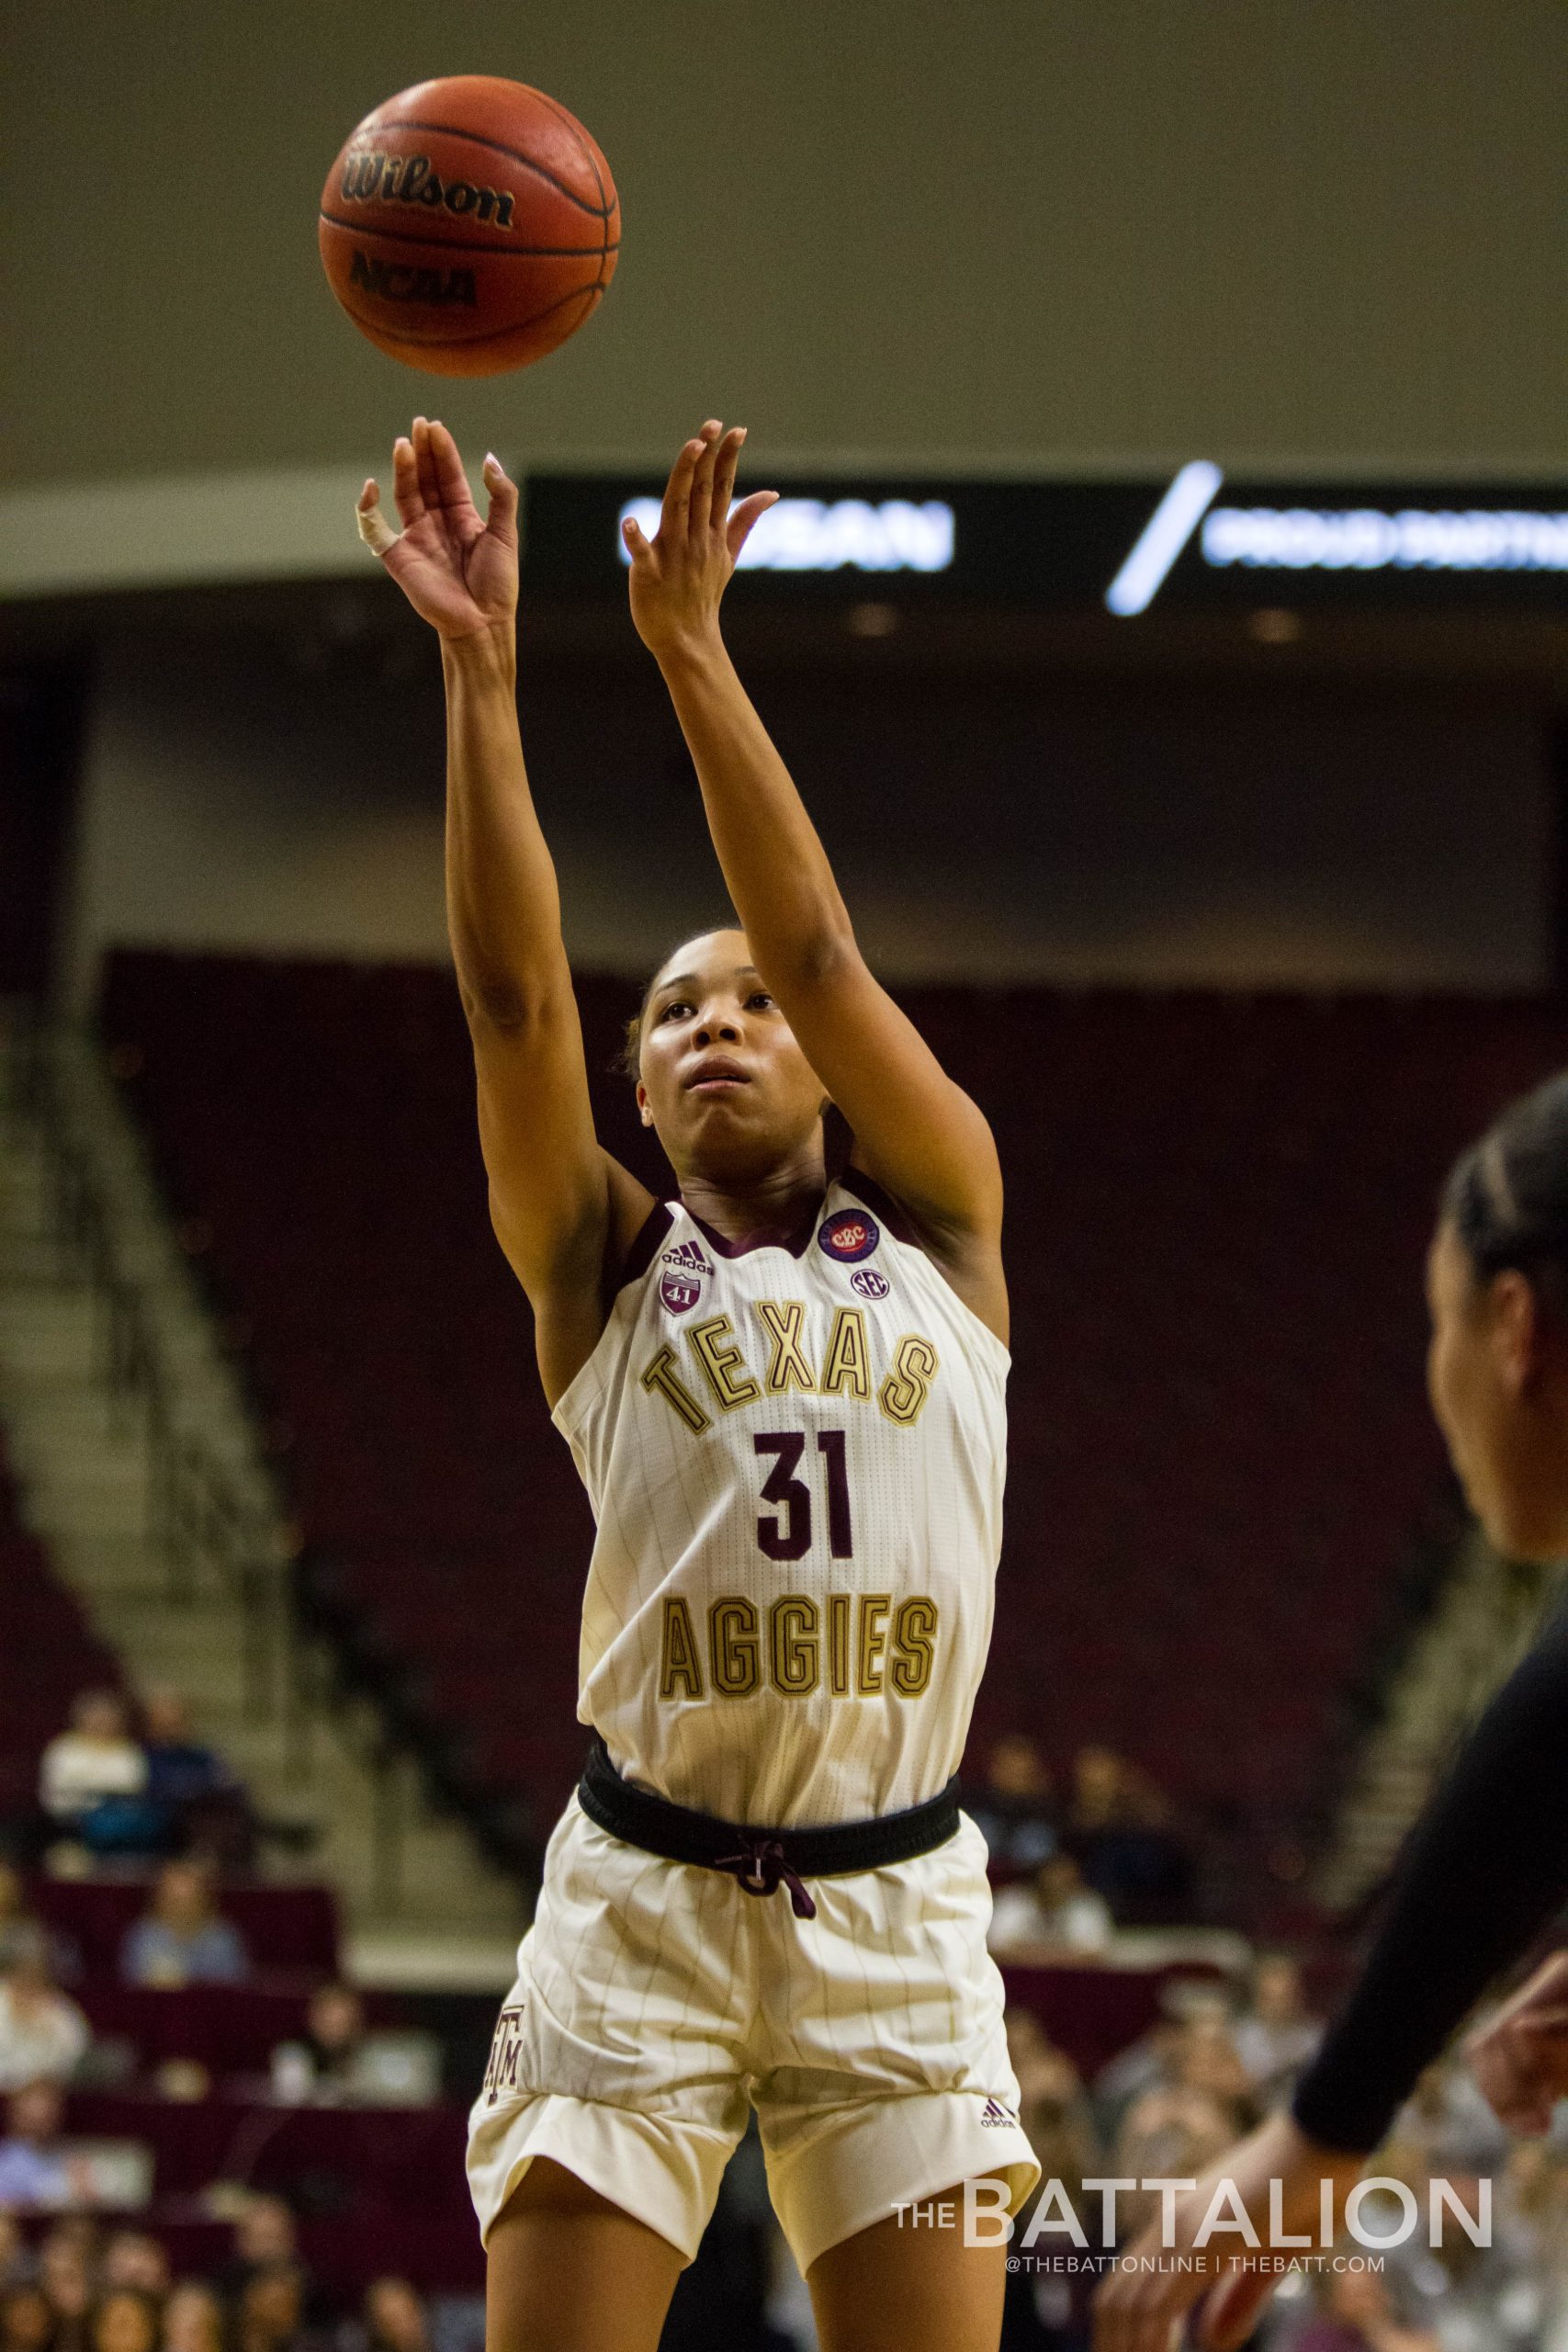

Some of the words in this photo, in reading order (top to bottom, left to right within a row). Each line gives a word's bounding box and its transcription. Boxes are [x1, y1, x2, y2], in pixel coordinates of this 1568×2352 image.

[341, 150, 514, 231] Wilson
[350, 249, 476, 305] NCAA
[661, 1253, 715, 1276] adidas
[832, 1225, 865, 1248] CBC
[666, 1286, 691, 1305] 41
[852, 1270, 887, 1296] SEC
[642, 1300, 940, 1436] TEXAS
[753, 1430, 853, 1562] 31
[658, 1593, 939, 1702] AGGIES
